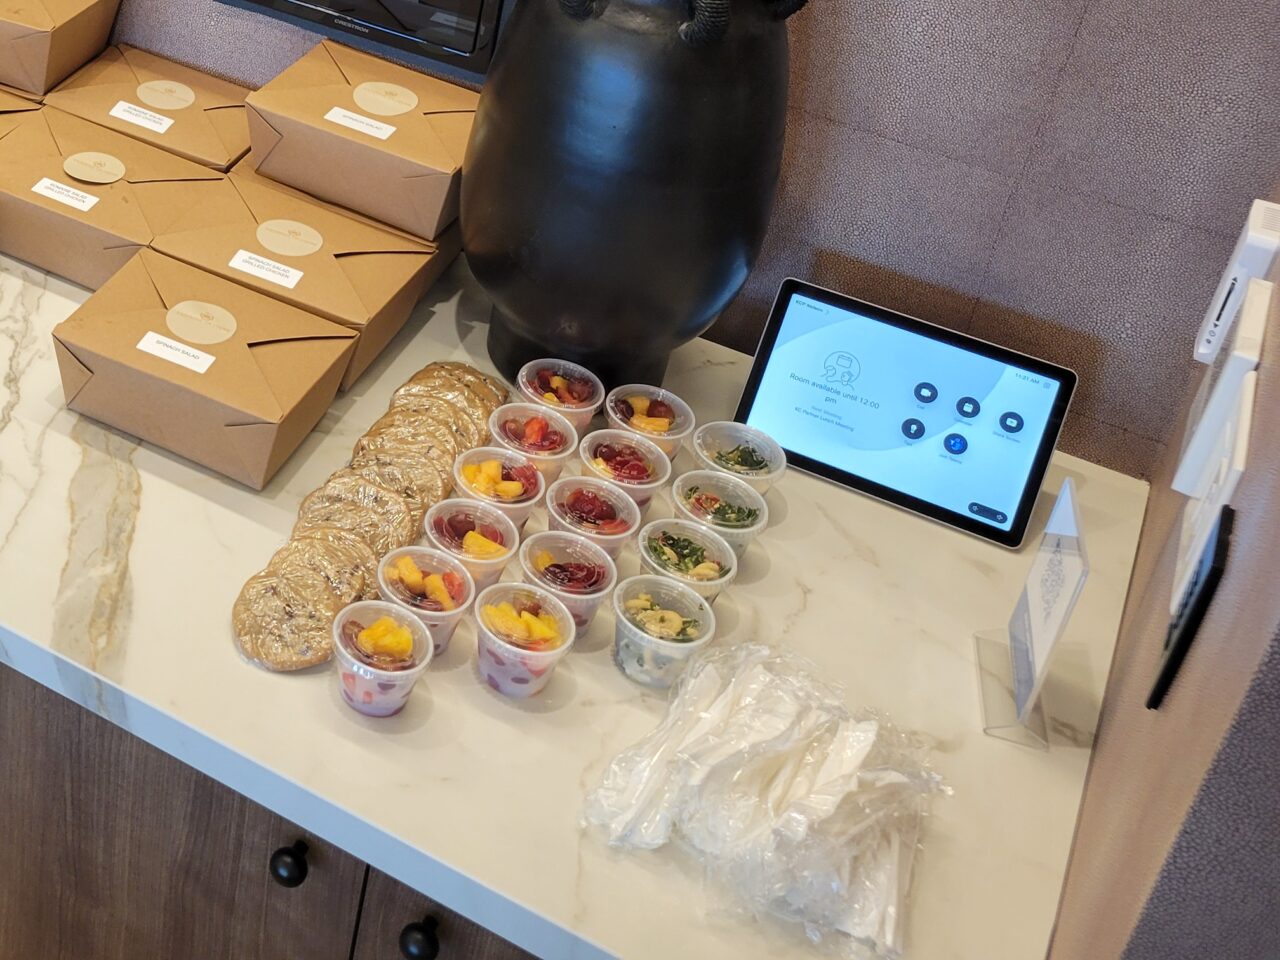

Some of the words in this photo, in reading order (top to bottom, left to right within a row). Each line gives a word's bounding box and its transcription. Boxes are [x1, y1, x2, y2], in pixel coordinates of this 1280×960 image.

[334, 18, 369, 33] CRESTRON
[240, 258, 267, 271] GRILLED
[264, 267, 292, 280] CHICKEN
[246, 255, 273, 268] SPINACH
[271, 264, 292, 275] SALAD
[154, 339, 182, 353] SPINACH
[180, 349, 201, 361] SALAD
[1015, 372, 1029, 381] 11:21
[789, 372, 810, 385] Room
[811, 381, 841, 396] available
[842, 391, 858, 402] until
[859, 397, 880, 409] 12:00
[824, 396, 837, 405] pm
